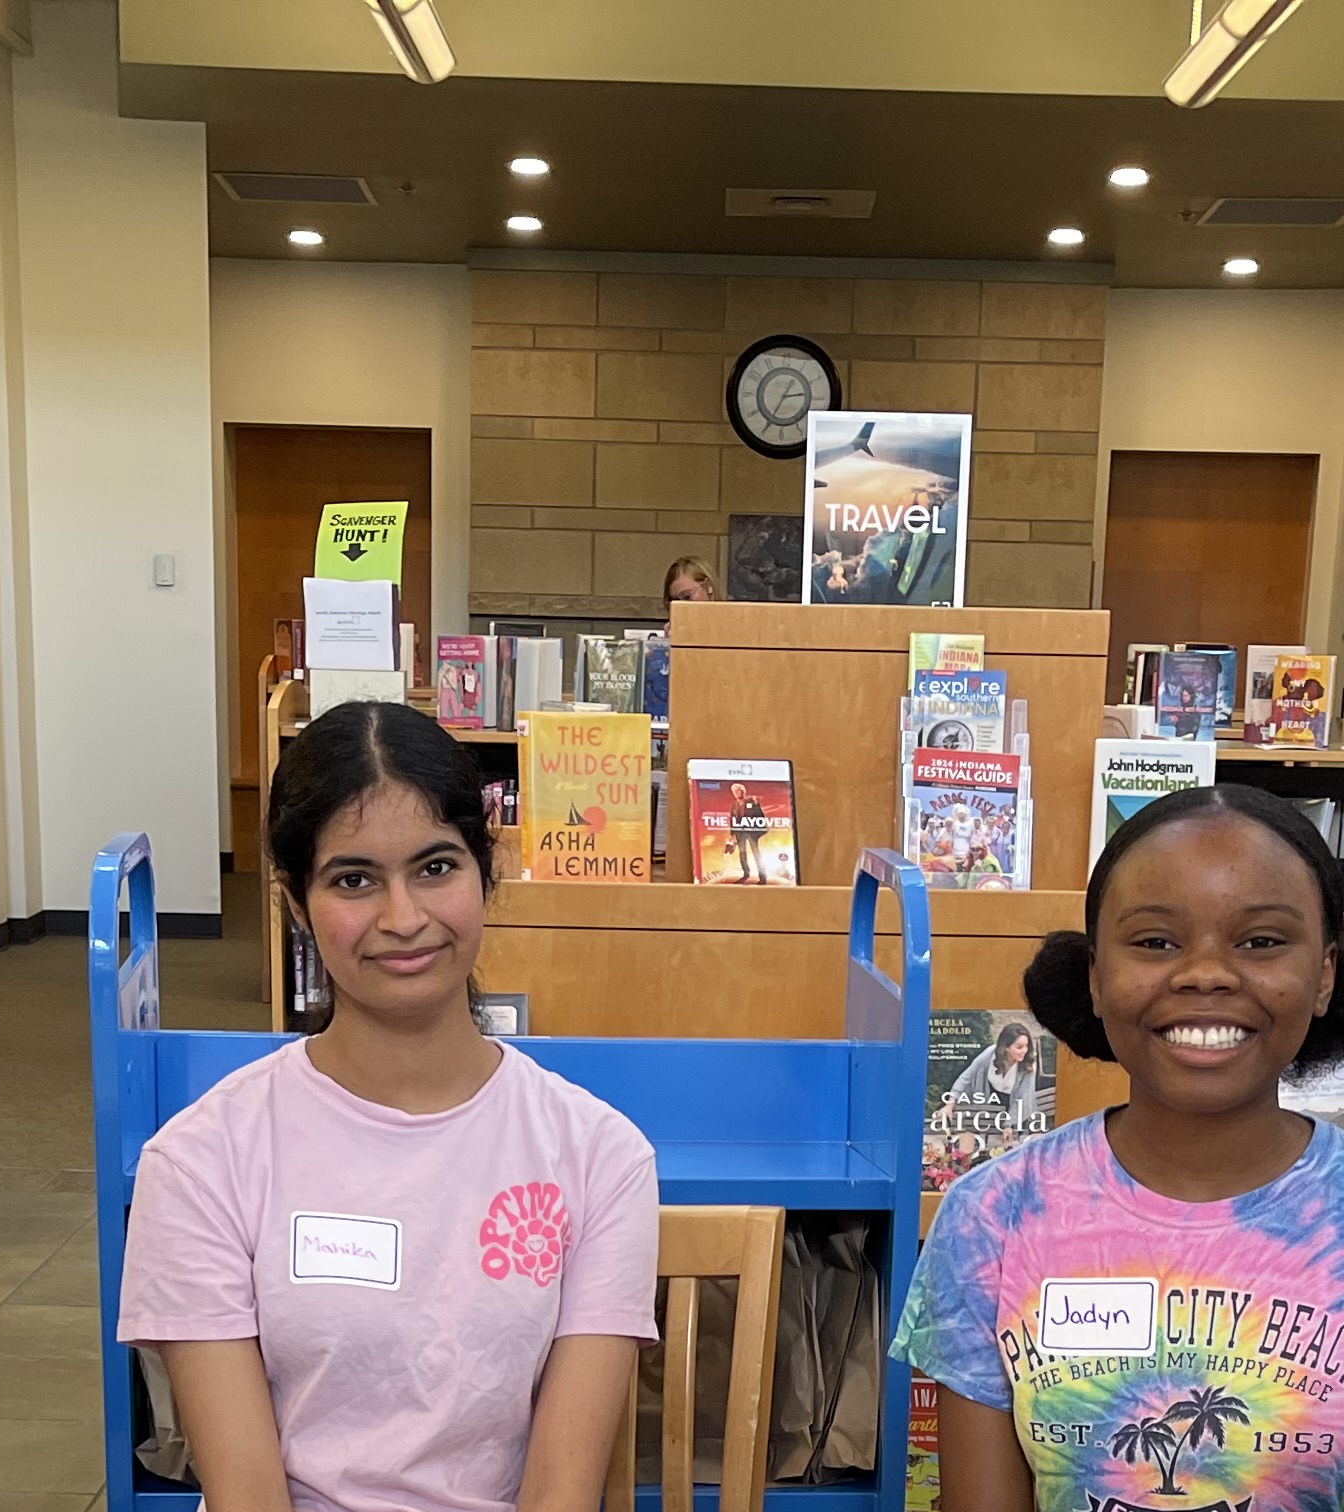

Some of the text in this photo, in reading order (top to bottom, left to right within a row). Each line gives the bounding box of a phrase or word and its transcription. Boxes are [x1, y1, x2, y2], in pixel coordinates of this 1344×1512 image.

[329, 514, 397, 526] SCAVENGER
[938, 650, 980, 664] INDIANA
[610, 673, 637, 683] BLOOD
[955, 693, 1001, 702] southern
[927, 701, 1000, 717] INDIANA
[1281, 720, 1311, 730] HEART
[557, 726, 602, 747] THE
[539, 753, 646, 777] WILDEST
[917, 765, 1013, 784] FESTIVAL GUIDE
[955, 760, 1003, 772] INDIANA
[1107, 758, 1194, 776] John Hodgman
[1101, 772, 1199, 792] Vacationland
[596, 783, 639, 805] SUN
[970, 795, 998, 817] FEST
[701, 816, 791, 828] THE LAYOVER
[540, 831, 596, 852] ASHA
[554, 856, 645, 877] LEMMIE
[929, 1018, 964, 1027] ARCELA
[930, 1027, 972, 1035] LADOLID
[940, 1091, 1002, 1105] CASA
[929, 1098, 1050, 1133] arcela
[1049, 1295, 1131, 1331] Jadyn
[1165, 1288, 1254, 1349] CITY
[1029, 1352, 1335, 1403] THE BEACH IS MY HAPPY PLACE
[1029, 1421, 1336, 1455] EST. 1953
